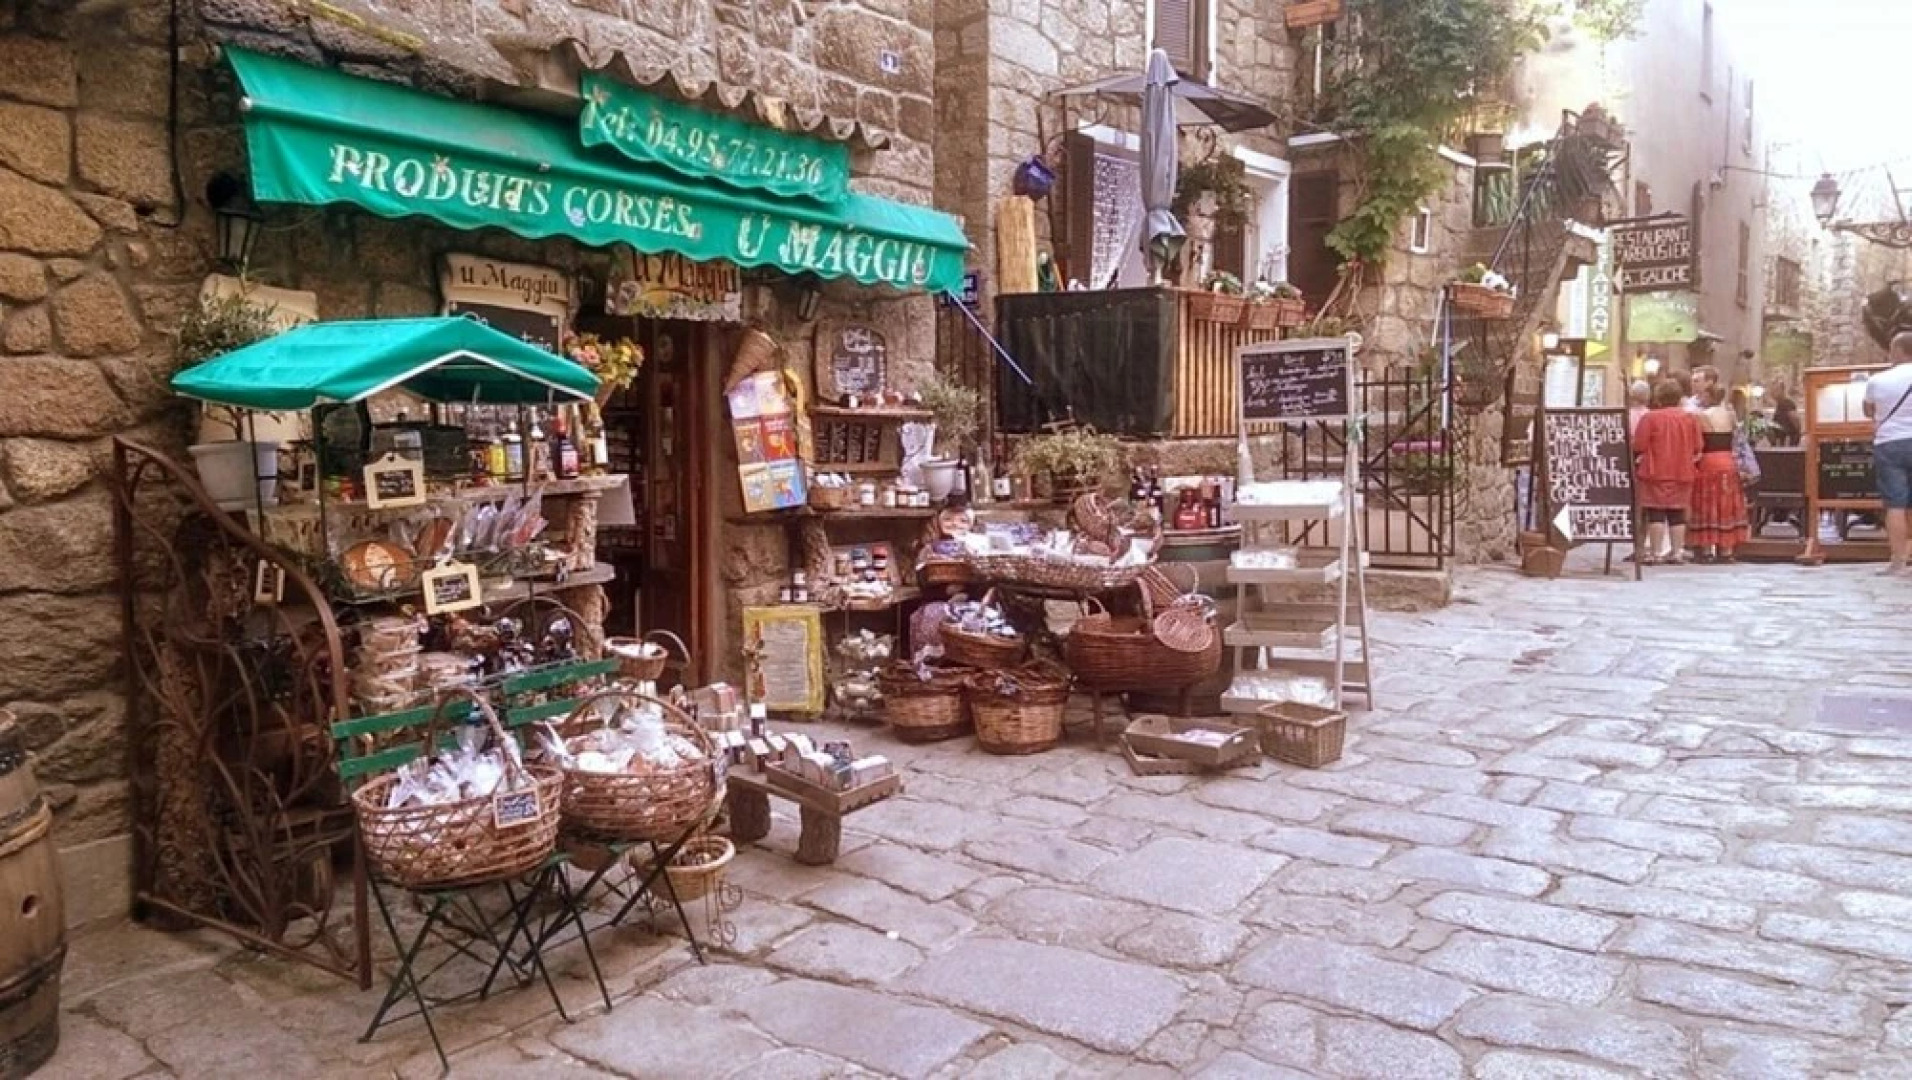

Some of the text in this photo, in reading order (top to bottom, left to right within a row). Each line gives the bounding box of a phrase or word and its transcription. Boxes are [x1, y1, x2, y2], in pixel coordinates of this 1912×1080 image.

[330, 144, 692, 237] PRODUITS CORSES
[1614, 226, 1689, 246] RESTAURANT
[737, 212, 938, 285] U MAGGIU
[482, 263, 558, 304] Maggiu
[1546, 414, 1622, 428] RESTAURANT
[1548, 441, 1601, 457] CUISINE
[1549, 456, 1619, 471] FAMILIALE
[1550, 486, 1590, 502] CORSE
